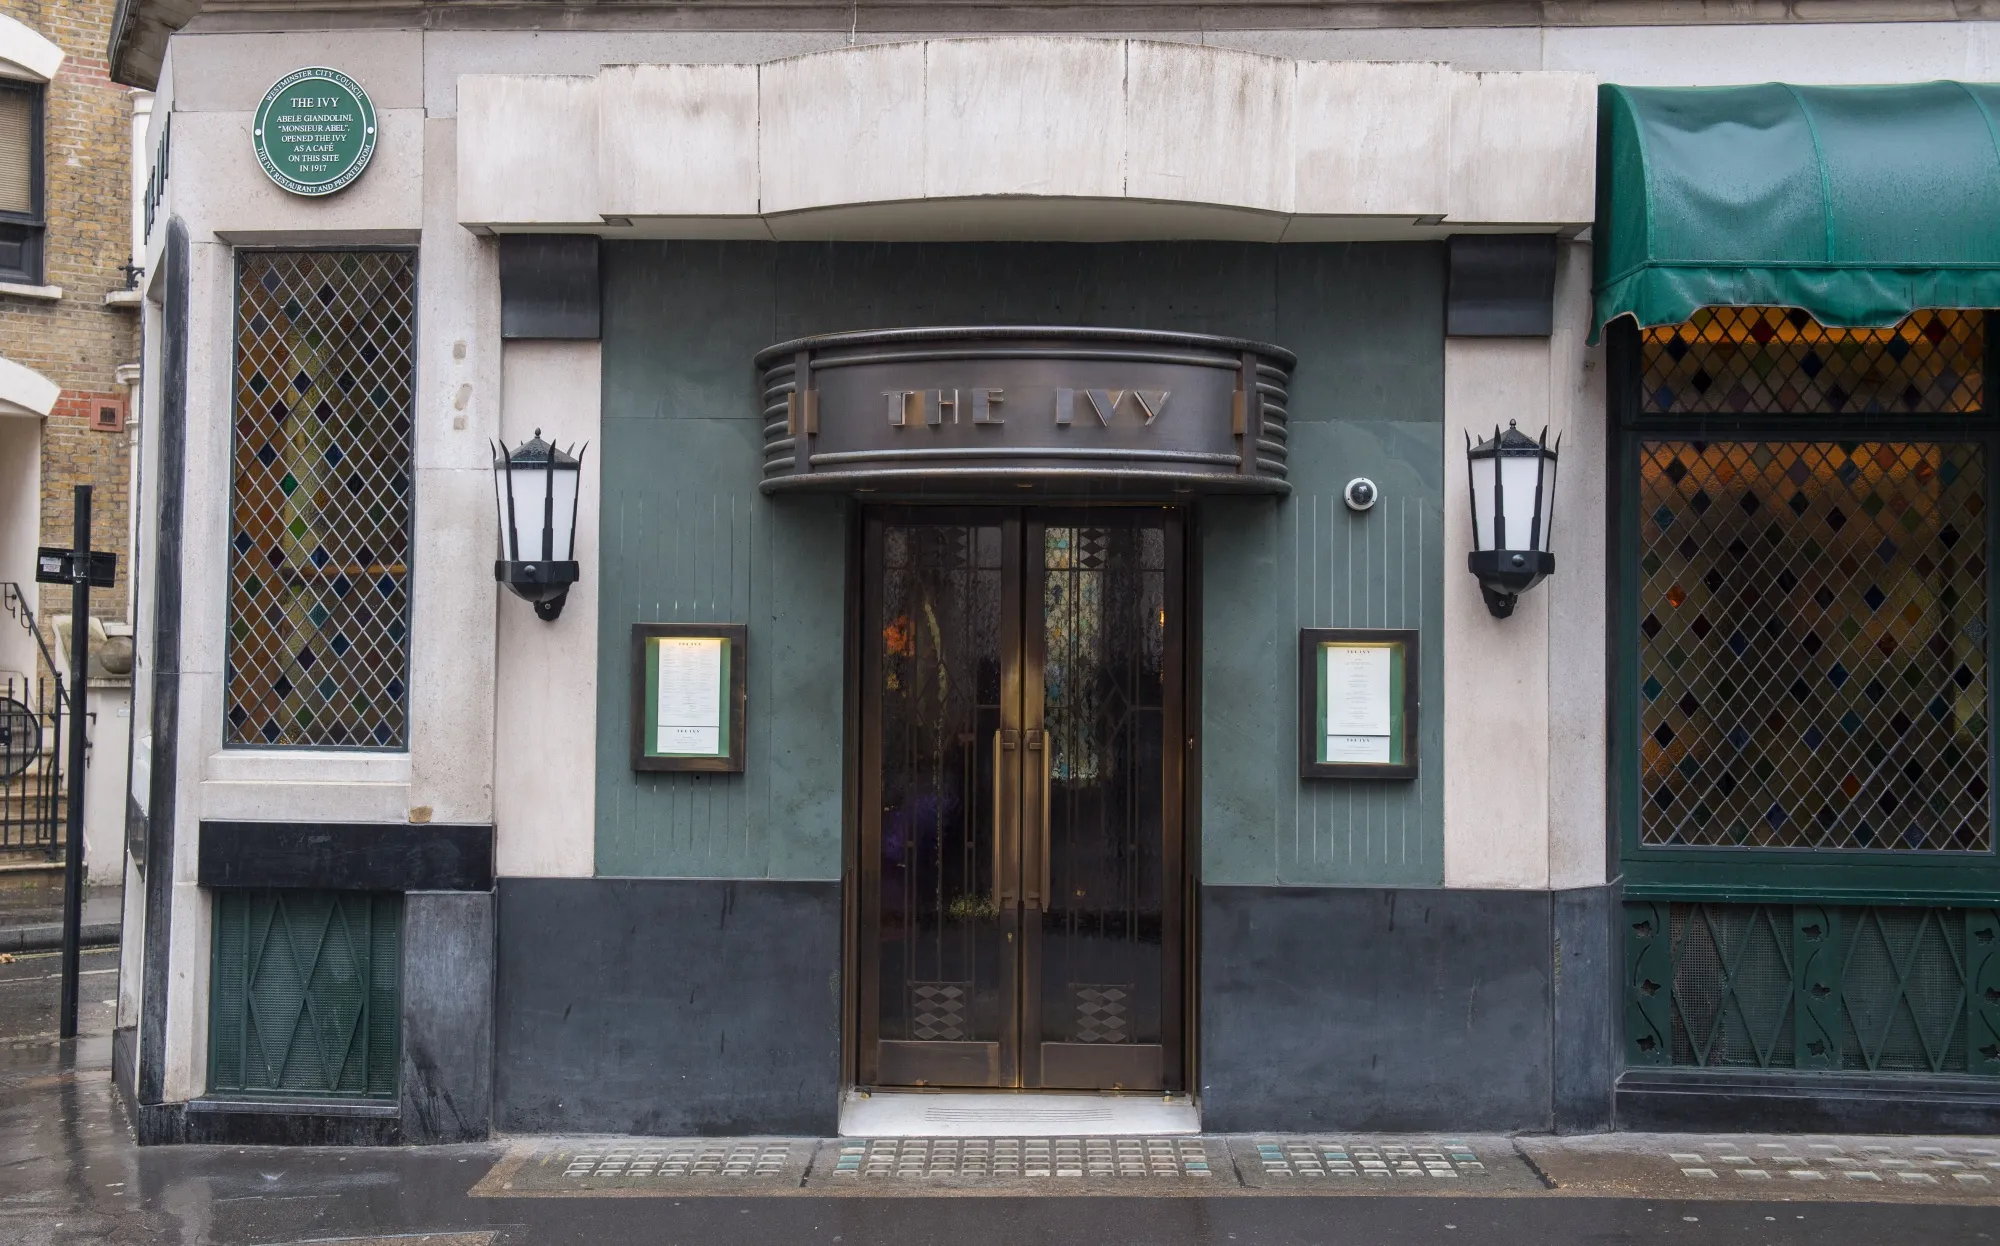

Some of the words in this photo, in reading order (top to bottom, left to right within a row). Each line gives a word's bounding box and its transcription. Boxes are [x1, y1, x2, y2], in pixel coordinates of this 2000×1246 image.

[266, 69, 312, 101] WESTMINSTER
[316, 69, 334, 77] CITY
[336, 74, 363, 100] COUNCIL
[291, 98, 314, 108] THE
[317, 97, 339, 107] IVY
[313, 142, 334, 152] CAFÉ
[258, 146, 266, 161] THE
[264, 161, 276, 174] IVY
[273, 173, 317, 192] RESTAURANT
[318, 183, 334, 192] AND
[334, 166, 360, 187] PRIVATE
[358, 144, 371, 167] ROOM
[881, 387, 1005, 426] THE
[1055, 388, 1171, 427] IVY
